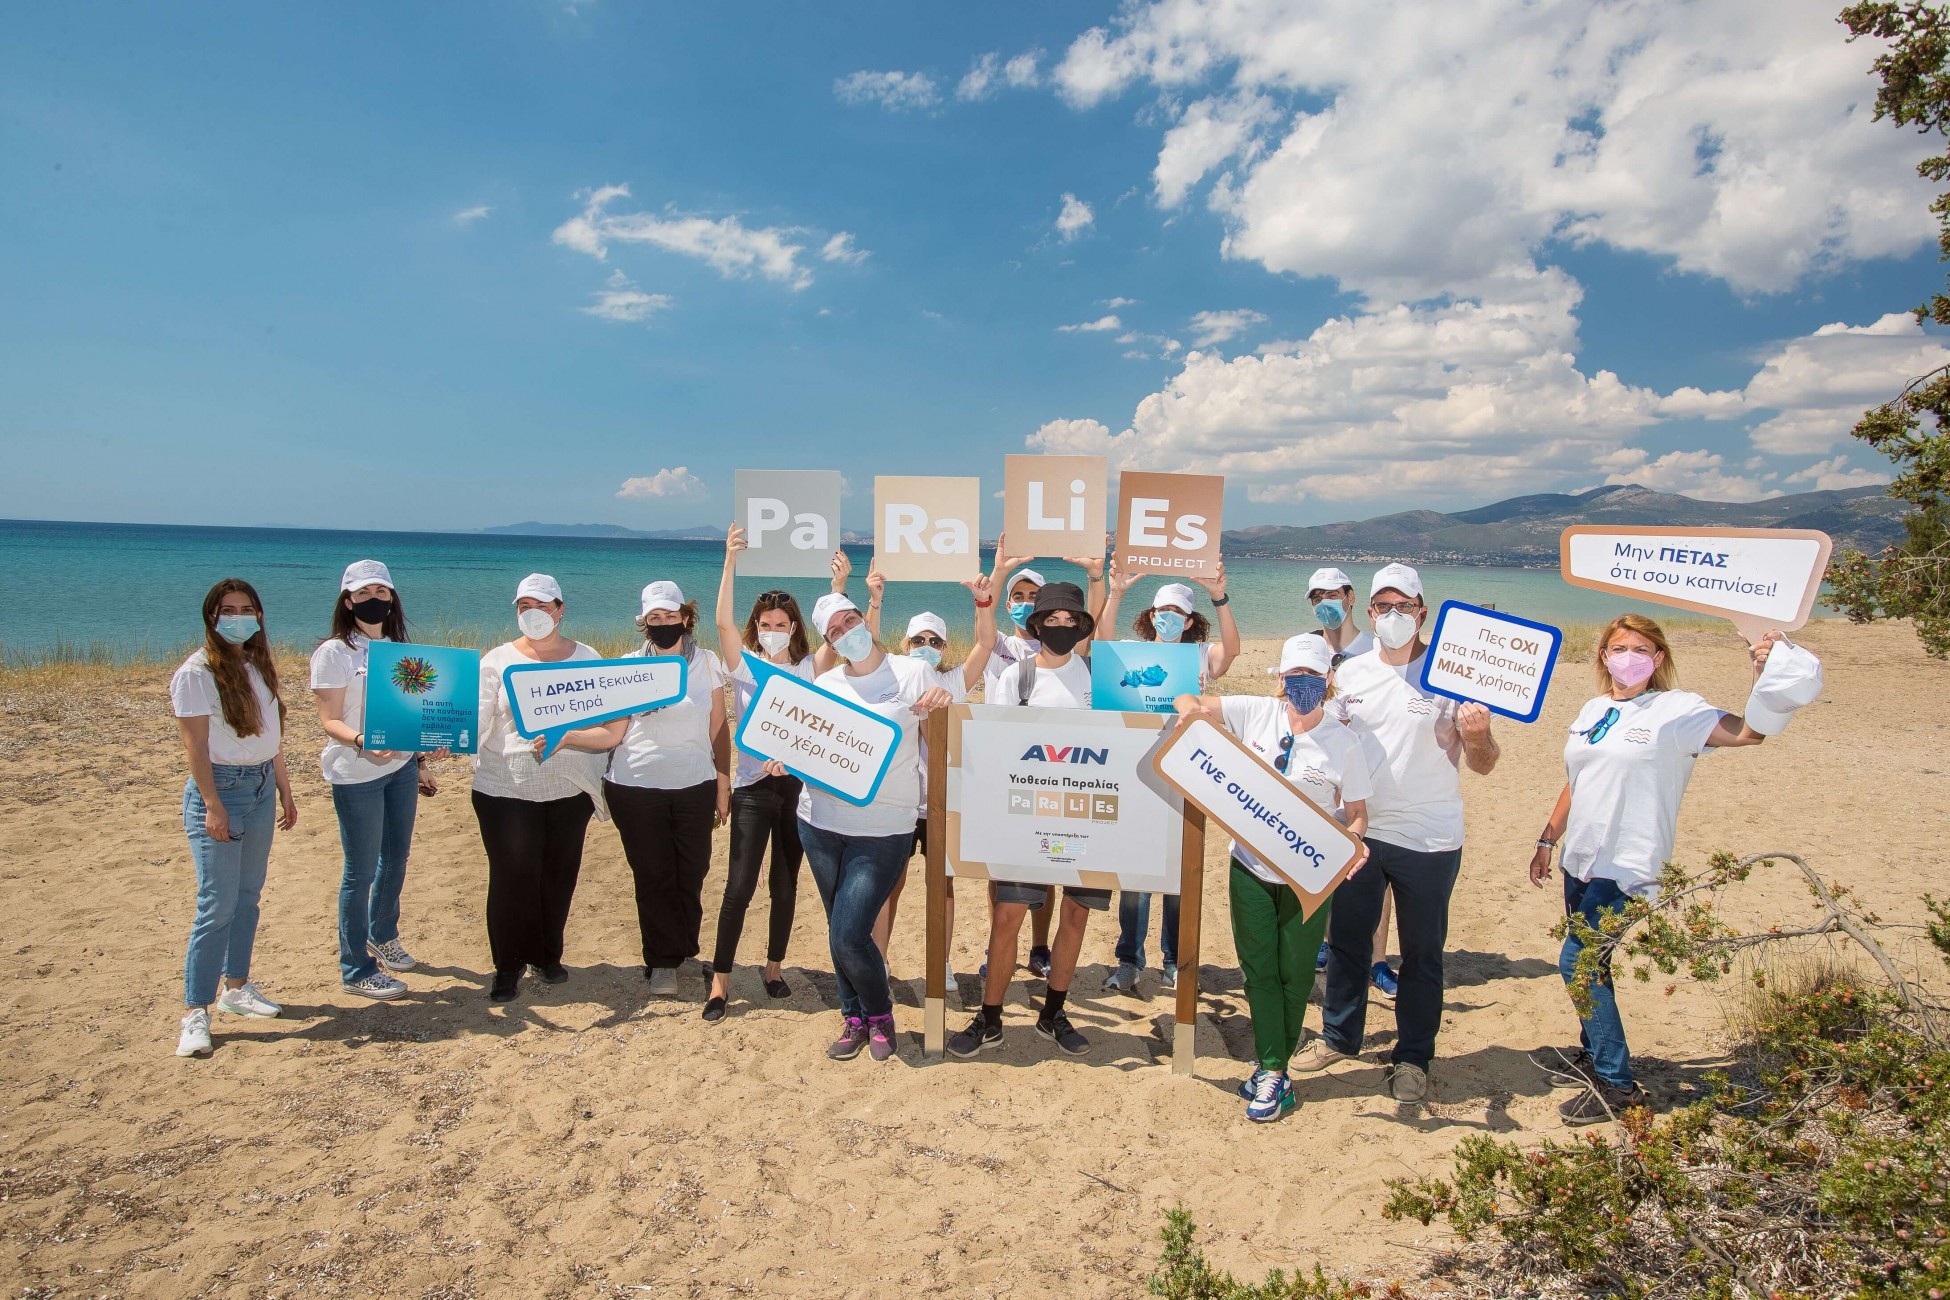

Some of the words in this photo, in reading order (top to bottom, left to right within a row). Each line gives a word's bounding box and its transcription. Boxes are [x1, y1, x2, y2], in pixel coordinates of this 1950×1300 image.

[1027, 479, 1086, 531] Li
[747, 497, 828, 550] Pa
[885, 503, 969, 555] Ra
[1128, 497, 1208, 550] Es
[1127, 555, 1207, 569] PROJECT
[1614, 542, 1654, 562] Μην
[1659, 547, 1729, 568] ΠΕΤΑΣ
[1610, 562, 1637, 581] ότι
[1643, 571, 1680, 585] σου
[1685, 576, 1778, 597] καπνίσει!
[1442, 642, 1467, 656] στα
[1470, 649, 1537, 677] πλαστικά
[1478, 628, 1507, 649] Πες
[1510, 637, 1539, 656] ΟΧΙ
[530, 686, 542, 698] Η
[545, 678, 595, 696] ΔΡΑΣΗ
[599, 670, 655, 689] ξεκινάει
[1437, 658, 1475, 680] ΜΙΑΣ
[1476, 673, 1531, 699] χρήσης
[533, 701, 566, 716] στην
[569, 694, 603, 713] ξηρά
[769, 696, 785, 714] Η
[785, 705, 835, 737] ΛΥΣΗ
[835, 730, 874, 757] είναι
[760, 720, 789, 740] στο
[790, 734, 826, 759] χέρι
[829, 752, 860, 774] σου
[1020, 744, 1109, 765] AVIN
[1009, 773, 1059, 786] Υιοθεσία
[1062, 777, 1119, 792] Παραλίας
[1011, 795, 1031, 809] Pa
[1038, 797, 1059, 810] Ra
[1069, 799, 1084, 812] Li
[1095, 800, 1115, 814] Es
[1189, 748, 1226, 784] Γίνε
[1226, 781, 1325, 868] συμμέτοχος
